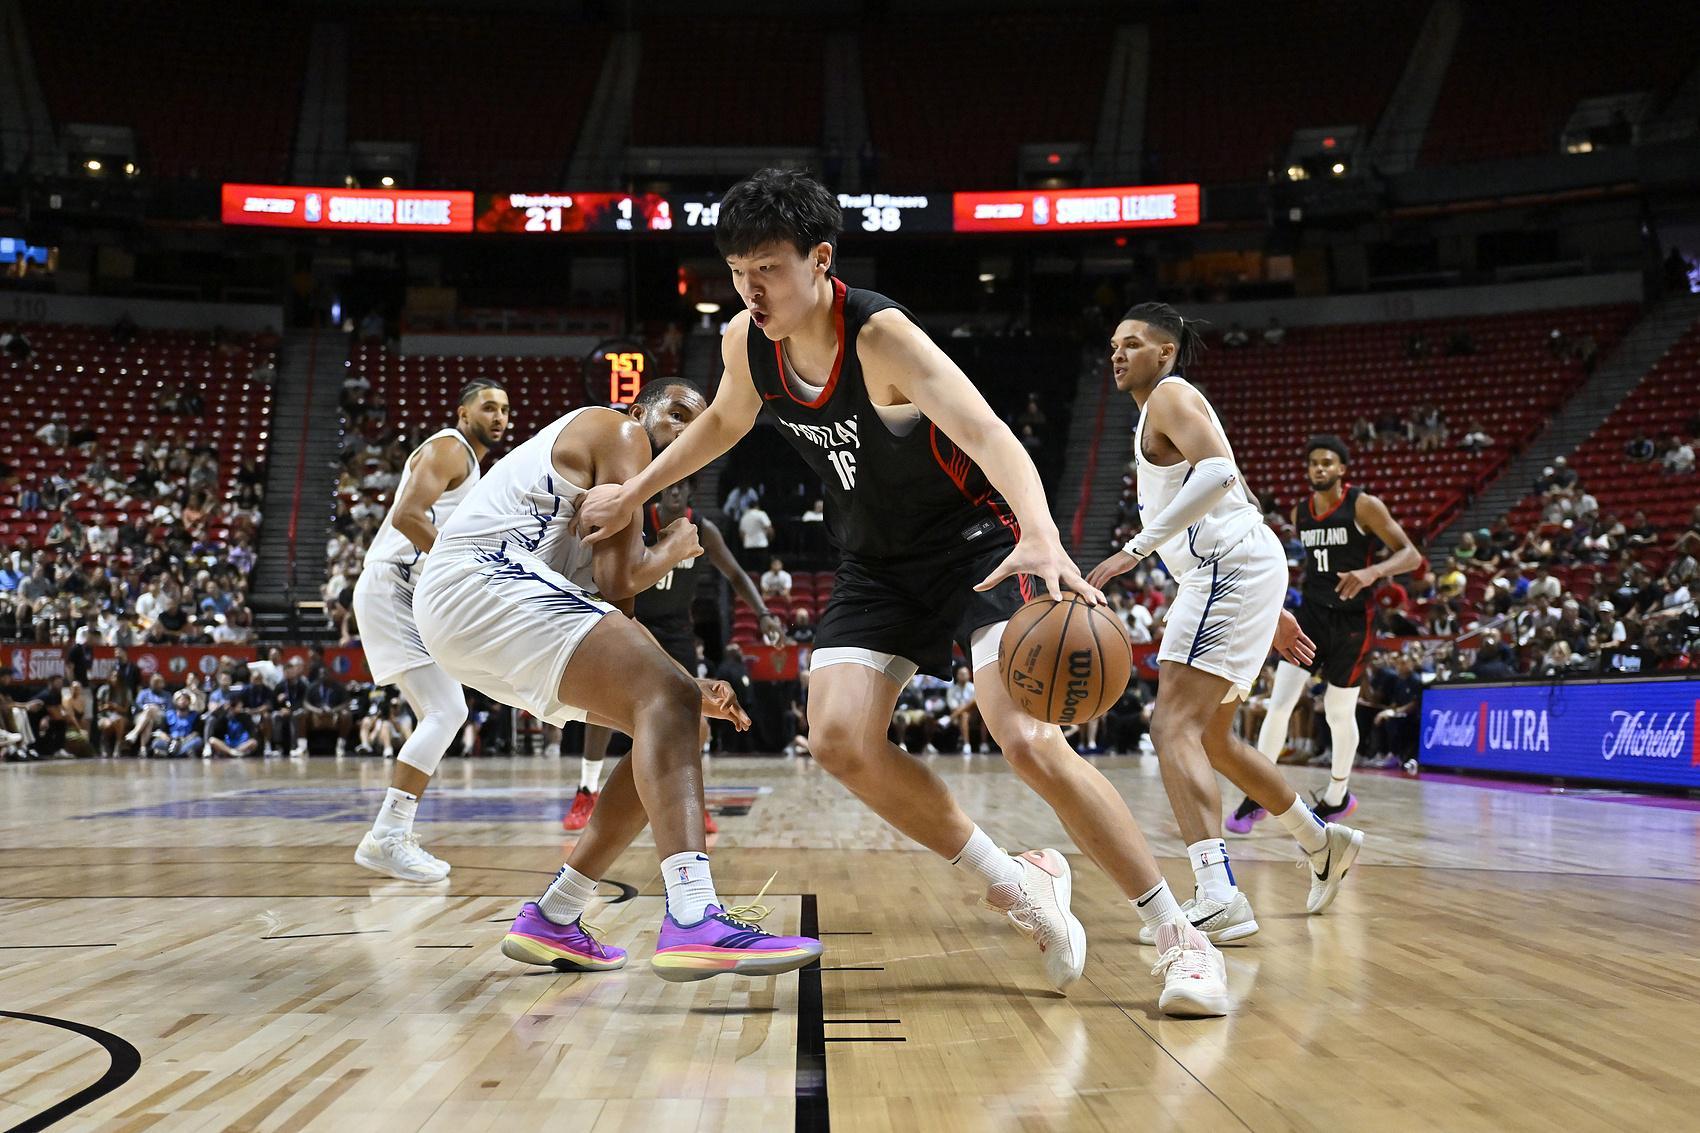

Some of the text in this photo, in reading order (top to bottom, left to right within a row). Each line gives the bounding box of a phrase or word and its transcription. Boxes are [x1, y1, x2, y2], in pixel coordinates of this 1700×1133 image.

[524, 206, 562, 232] 21
[617, 198, 632, 220] 1
[861, 207, 901, 232] 38
[610, 370, 640, 404] 13
[827, 450, 857, 491] 16
[1300, 527, 1348, 547] PORTLAND
[1056, 647, 1093, 724] Wilson
[1489, 709, 1550, 752] ULTRA
[1601, 710, 1691, 761] Michelob
